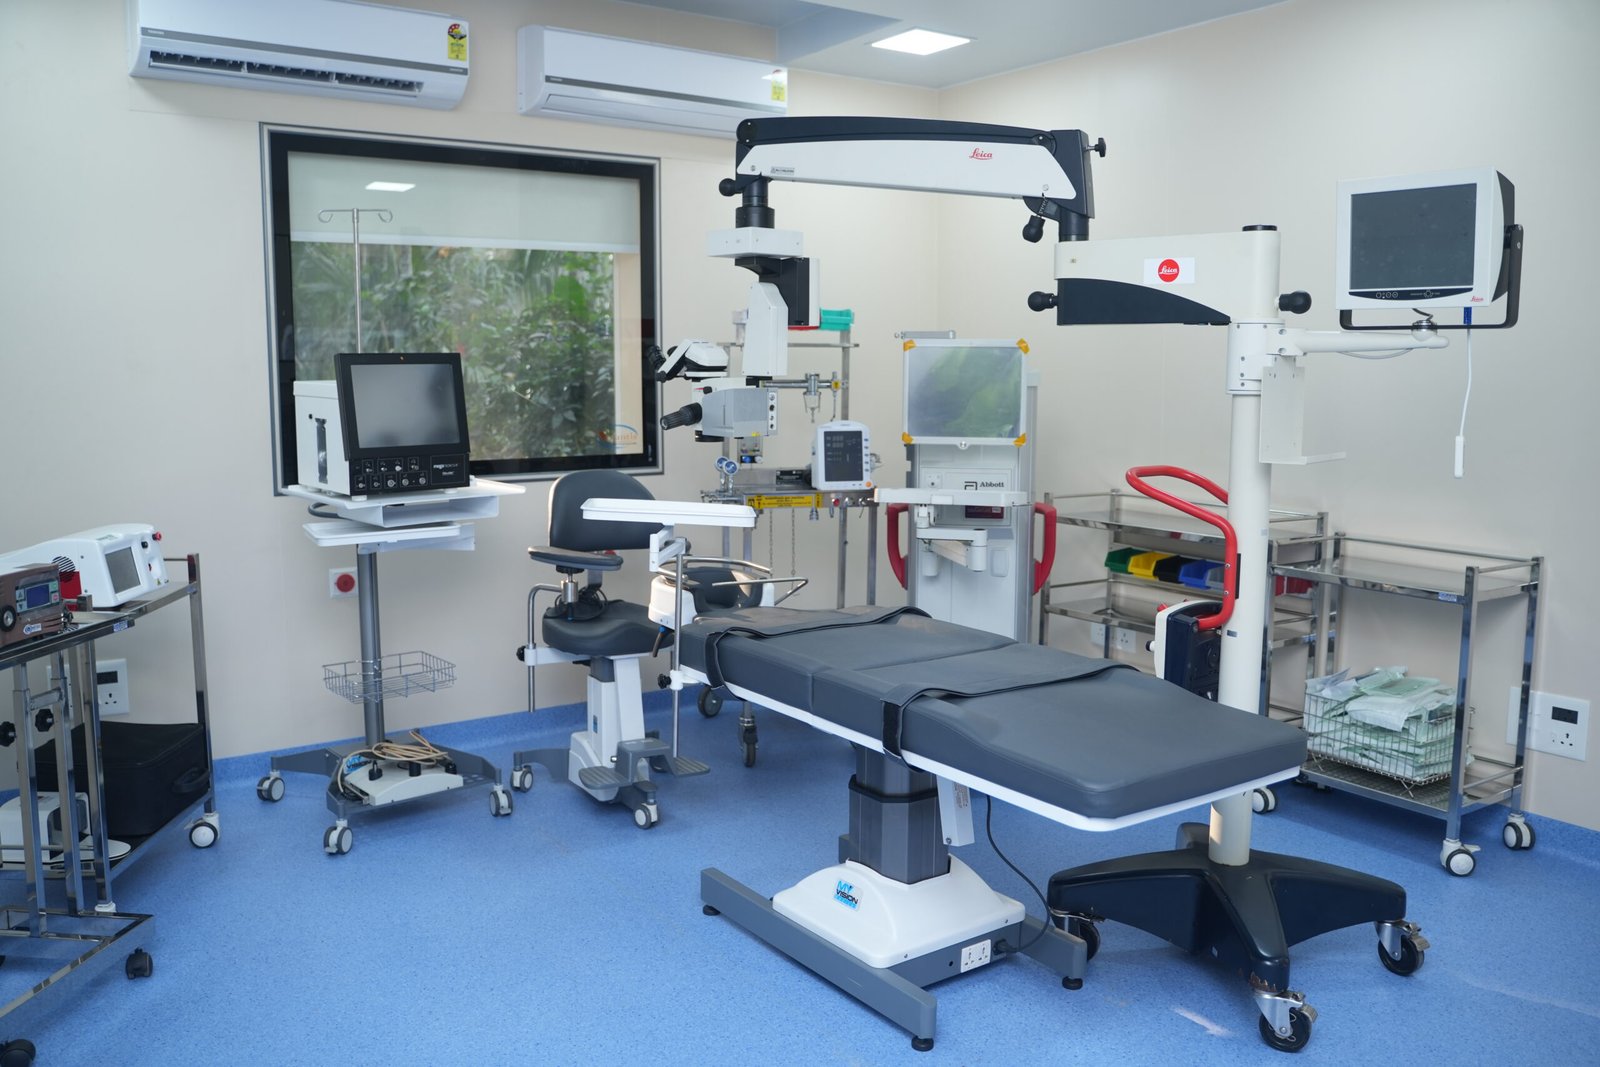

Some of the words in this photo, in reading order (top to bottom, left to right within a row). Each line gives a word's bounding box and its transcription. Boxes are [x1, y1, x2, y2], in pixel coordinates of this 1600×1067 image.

[969, 147, 993, 160] Leica
[1159, 266, 1178, 275] Leica
[837, 880, 853, 893] MY
[836, 889, 859, 905] VISION
